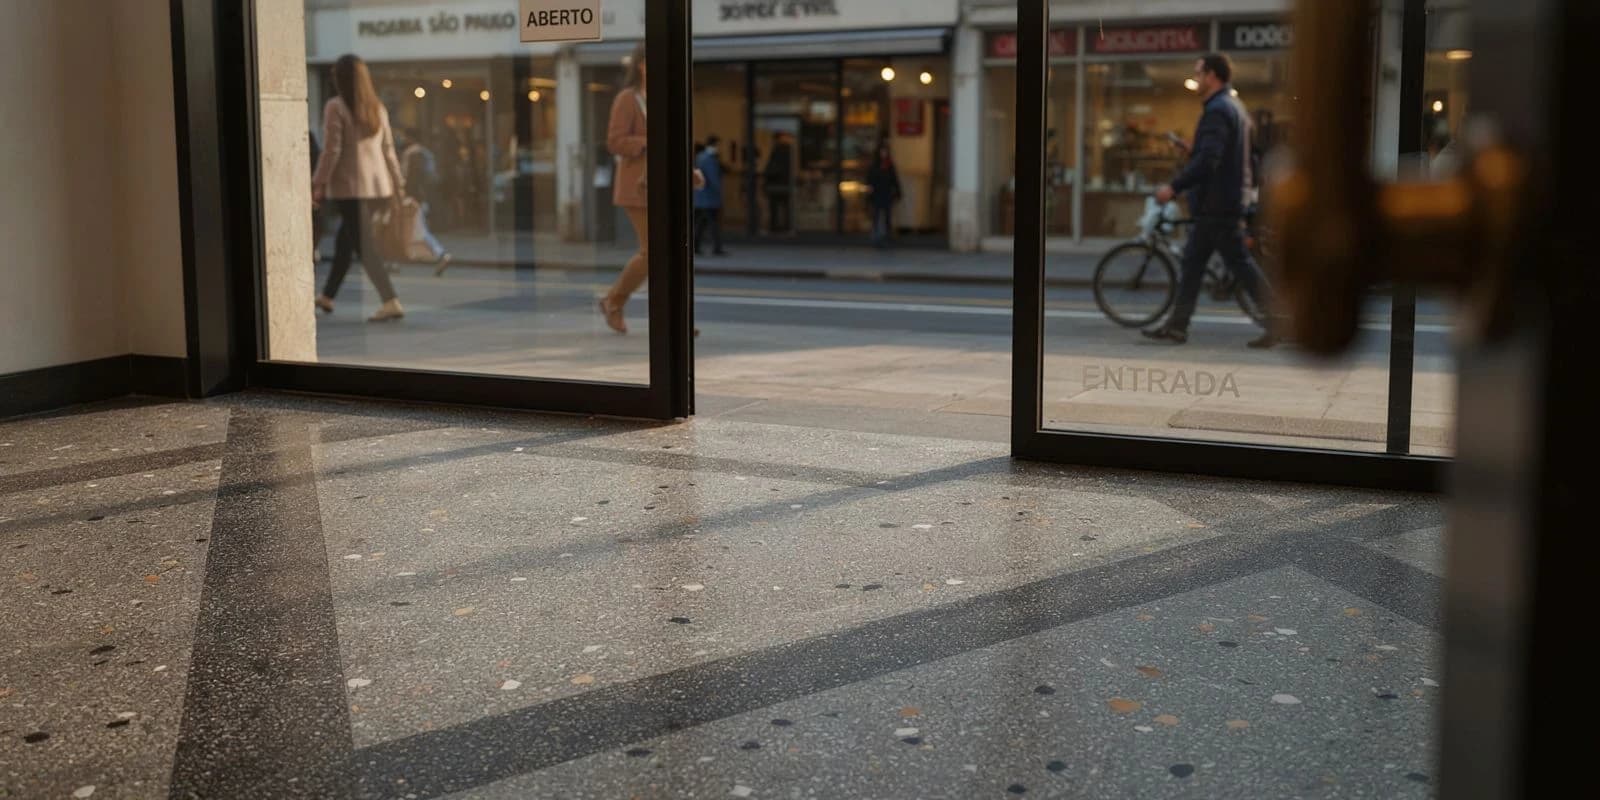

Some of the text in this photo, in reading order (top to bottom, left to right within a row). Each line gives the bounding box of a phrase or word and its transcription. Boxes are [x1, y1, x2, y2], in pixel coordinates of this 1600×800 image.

[429, 12, 459, 34] SÃO
[464, 12, 516, 31] PAULO
[527, 8, 593, 28] ABERTO
[1082, 365, 1240, 398] ENTRADA
